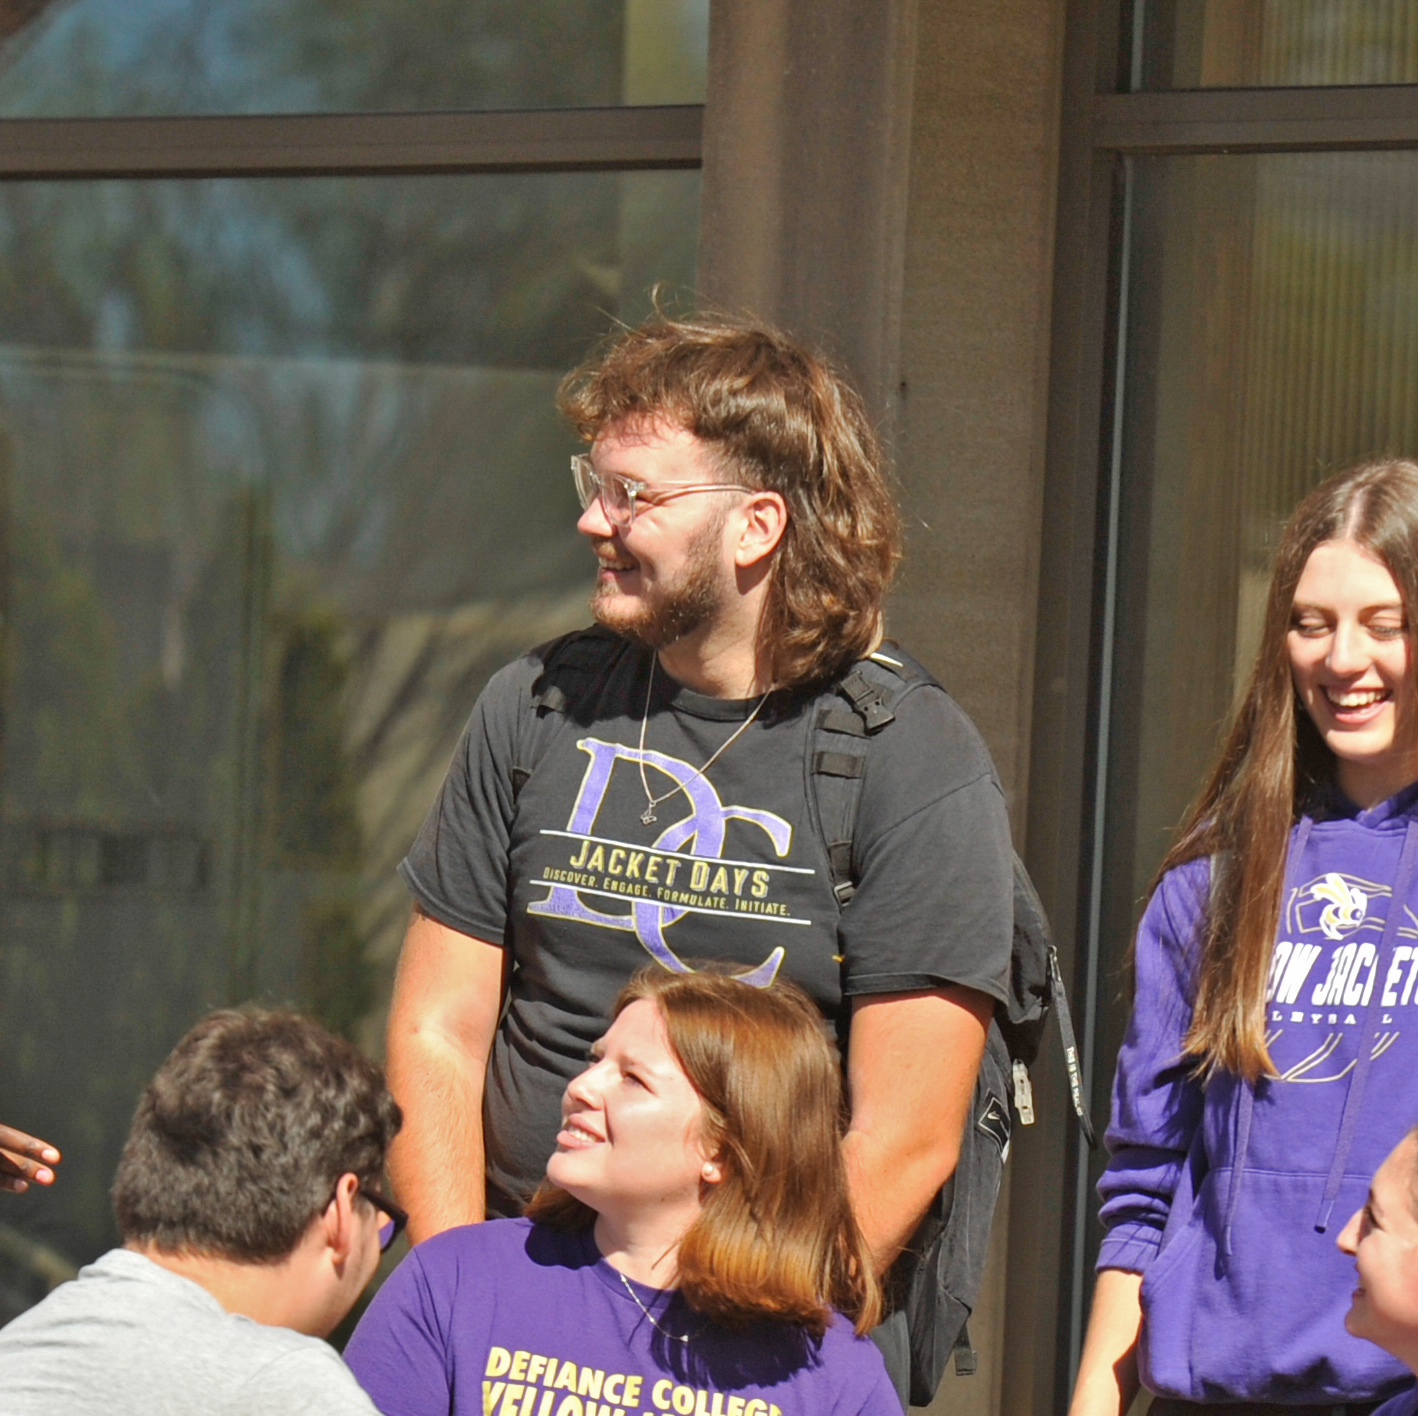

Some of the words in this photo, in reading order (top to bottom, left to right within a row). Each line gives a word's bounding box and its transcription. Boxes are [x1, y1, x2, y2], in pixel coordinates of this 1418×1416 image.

[542, 866, 599, 888] DISCOVER.
[602, 876, 653, 898] ENGAGE.
[656, 886, 729, 910] FORMULATE.
[734, 898, 791, 917] INITIATE.
[569, 840, 682, 886] JACKET
[689, 860, 771, 898] DAYS
[484, 1346, 643, 1408] DEFIANCE
